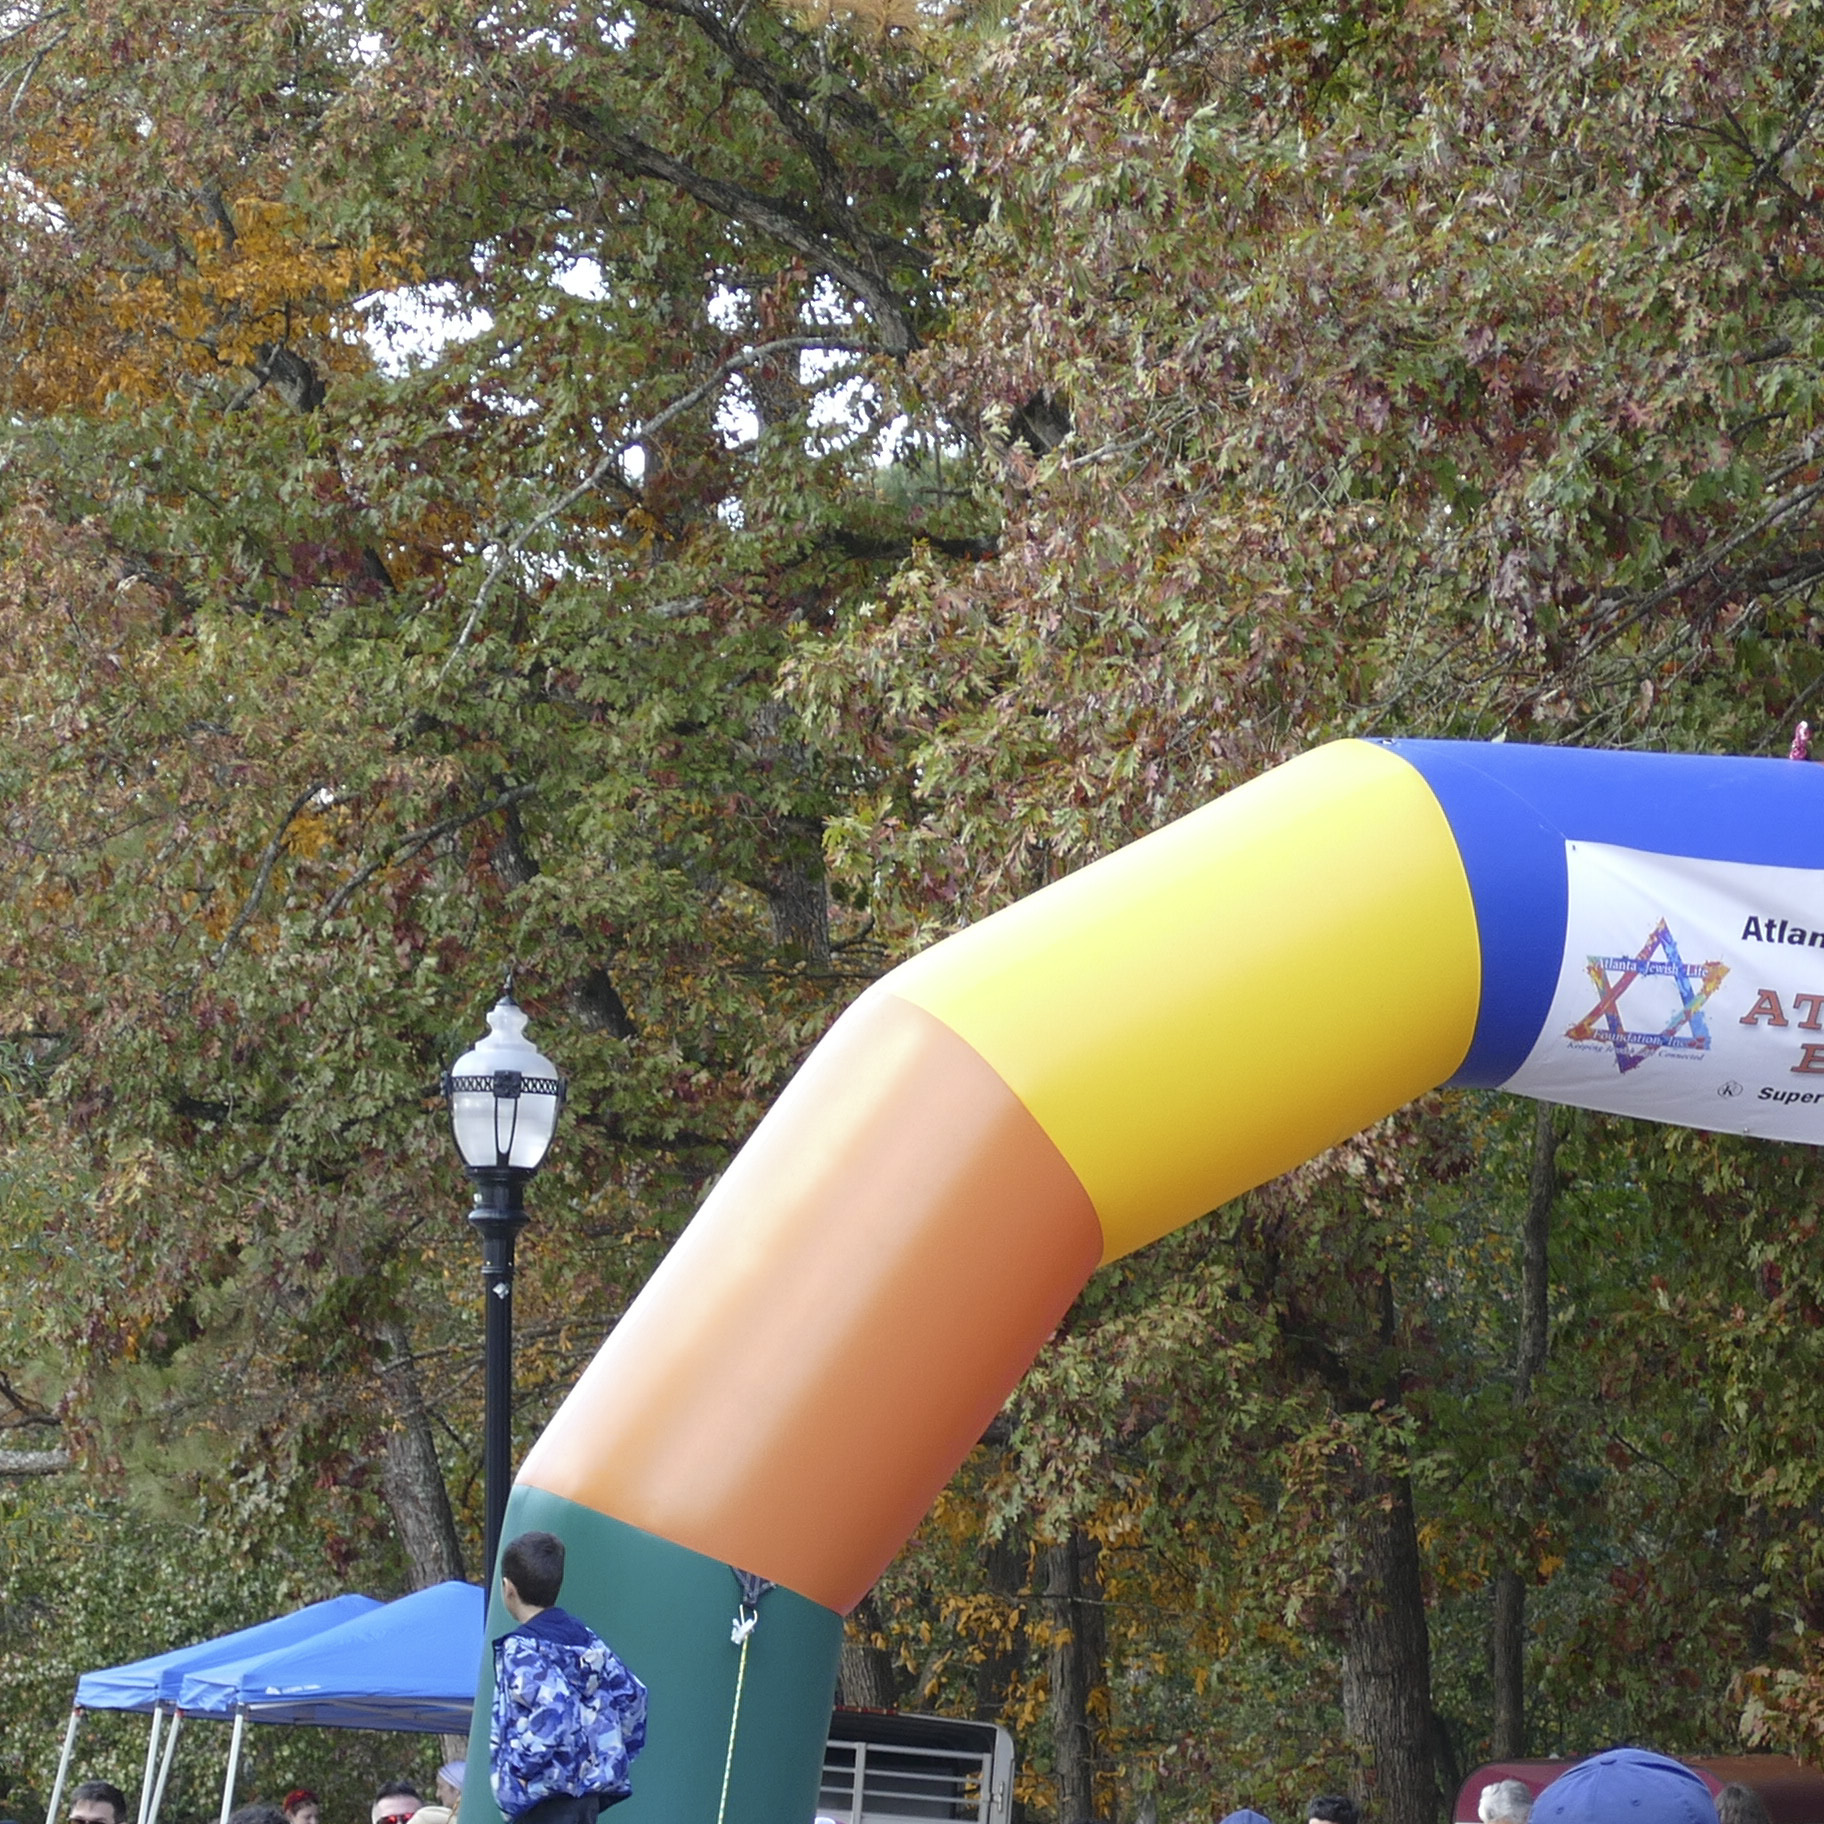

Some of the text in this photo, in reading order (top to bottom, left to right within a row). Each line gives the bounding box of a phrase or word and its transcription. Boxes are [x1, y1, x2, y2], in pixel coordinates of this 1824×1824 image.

[1595, 958, 1709, 977] Atlanta Jewish Life
